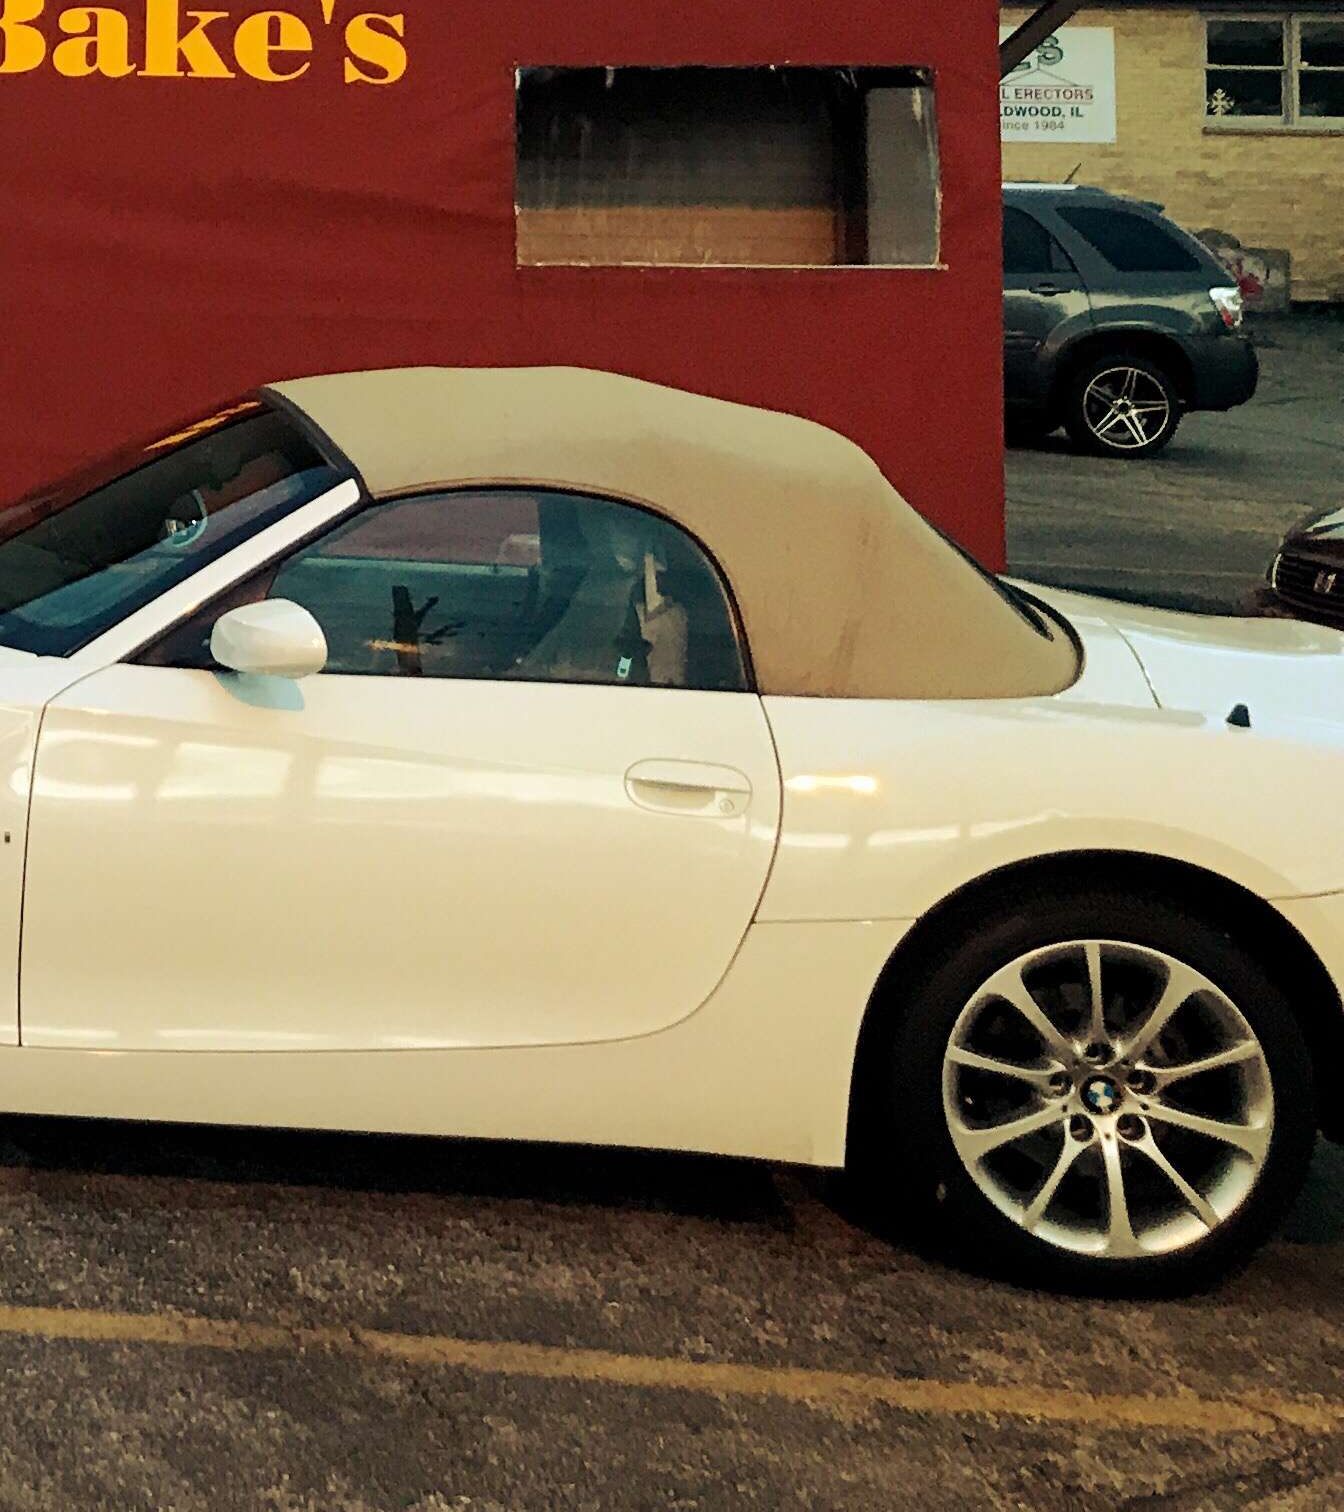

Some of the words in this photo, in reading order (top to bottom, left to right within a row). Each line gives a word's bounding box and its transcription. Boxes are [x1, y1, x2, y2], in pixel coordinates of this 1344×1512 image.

[1014, 88, 1094, 100] ERECTORS
[1000, 106, 1066, 118] DWOOD,
[1070, 106, 1084, 117] IL
[1002, 121, 1029, 130] ince
[1035, 120, 1065, 131] 1984
